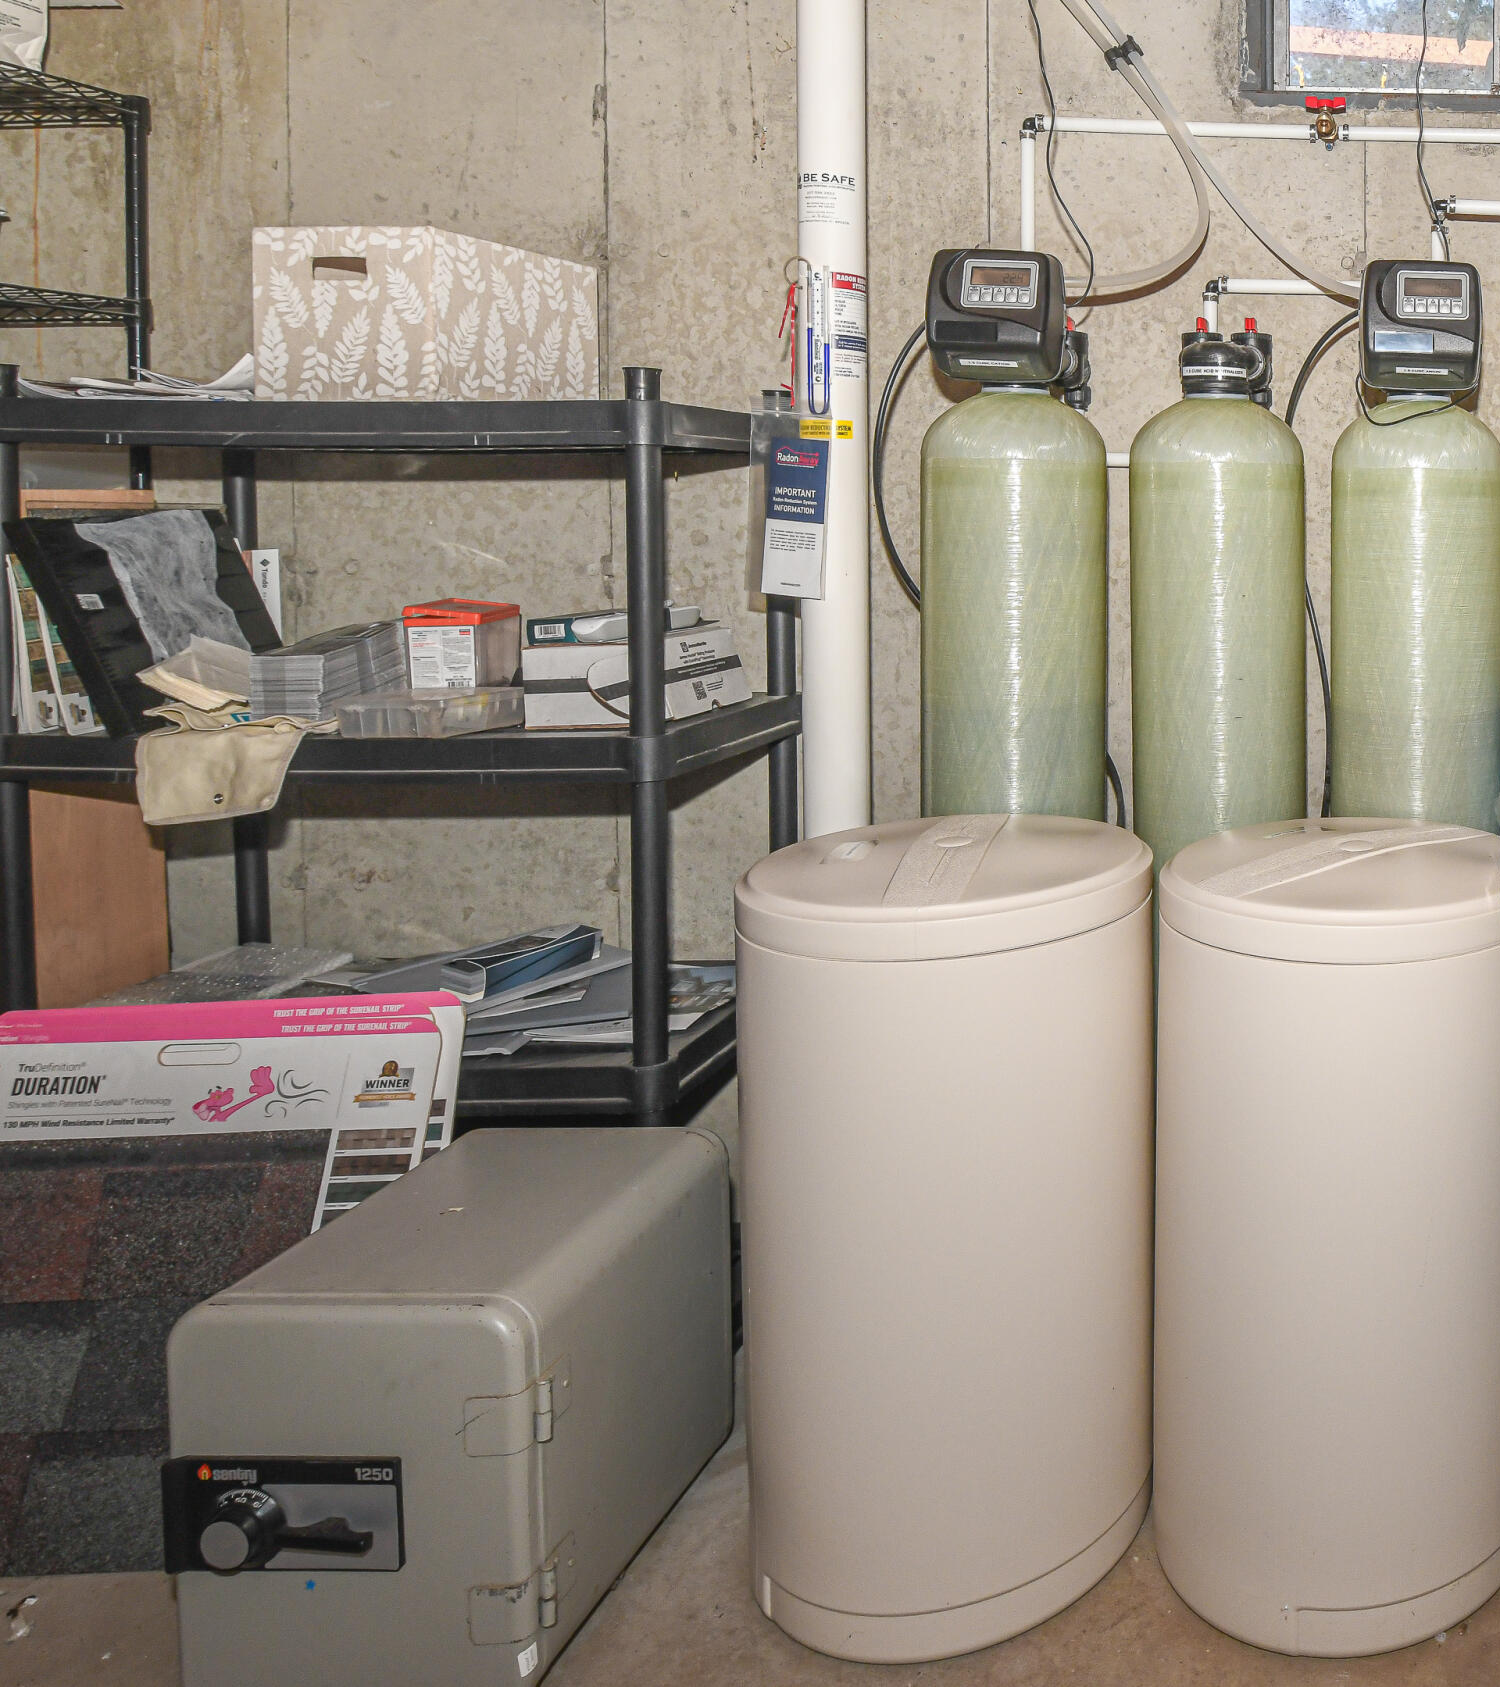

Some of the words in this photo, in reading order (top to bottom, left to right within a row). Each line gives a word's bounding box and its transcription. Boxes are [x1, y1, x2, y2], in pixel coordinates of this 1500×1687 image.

[803, 173, 818, 183] BE
[821, 173, 856, 187] SAFE
[774, 486, 816, 499] IMPORTANT
[774, 504, 815, 515] INFORMATION
[274, 1009, 294, 1018] TRUST
[296, 1008, 308, 1016] THE
[308, 1008, 326, 1016] GRIP
[326, 1007, 334, 1015] OF
[336, 1006, 348, 1014] THE
[302, 1024, 316, 1032] THE
[334, 1024, 344, 1032] OF
[344, 1024, 356, 1032] THE
[390, 1022, 409, 1030] STRIP
[10, 1076, 102, 1096] DURATION
[365, 1078, 410, 1089] WINNER
[130, 1098, 172, 1106] Technology
[40, 1120, 61, 1128] Wind
[212, 1468, 257, 1484] sentry
[354, 1468, 394, 1480] 1250
